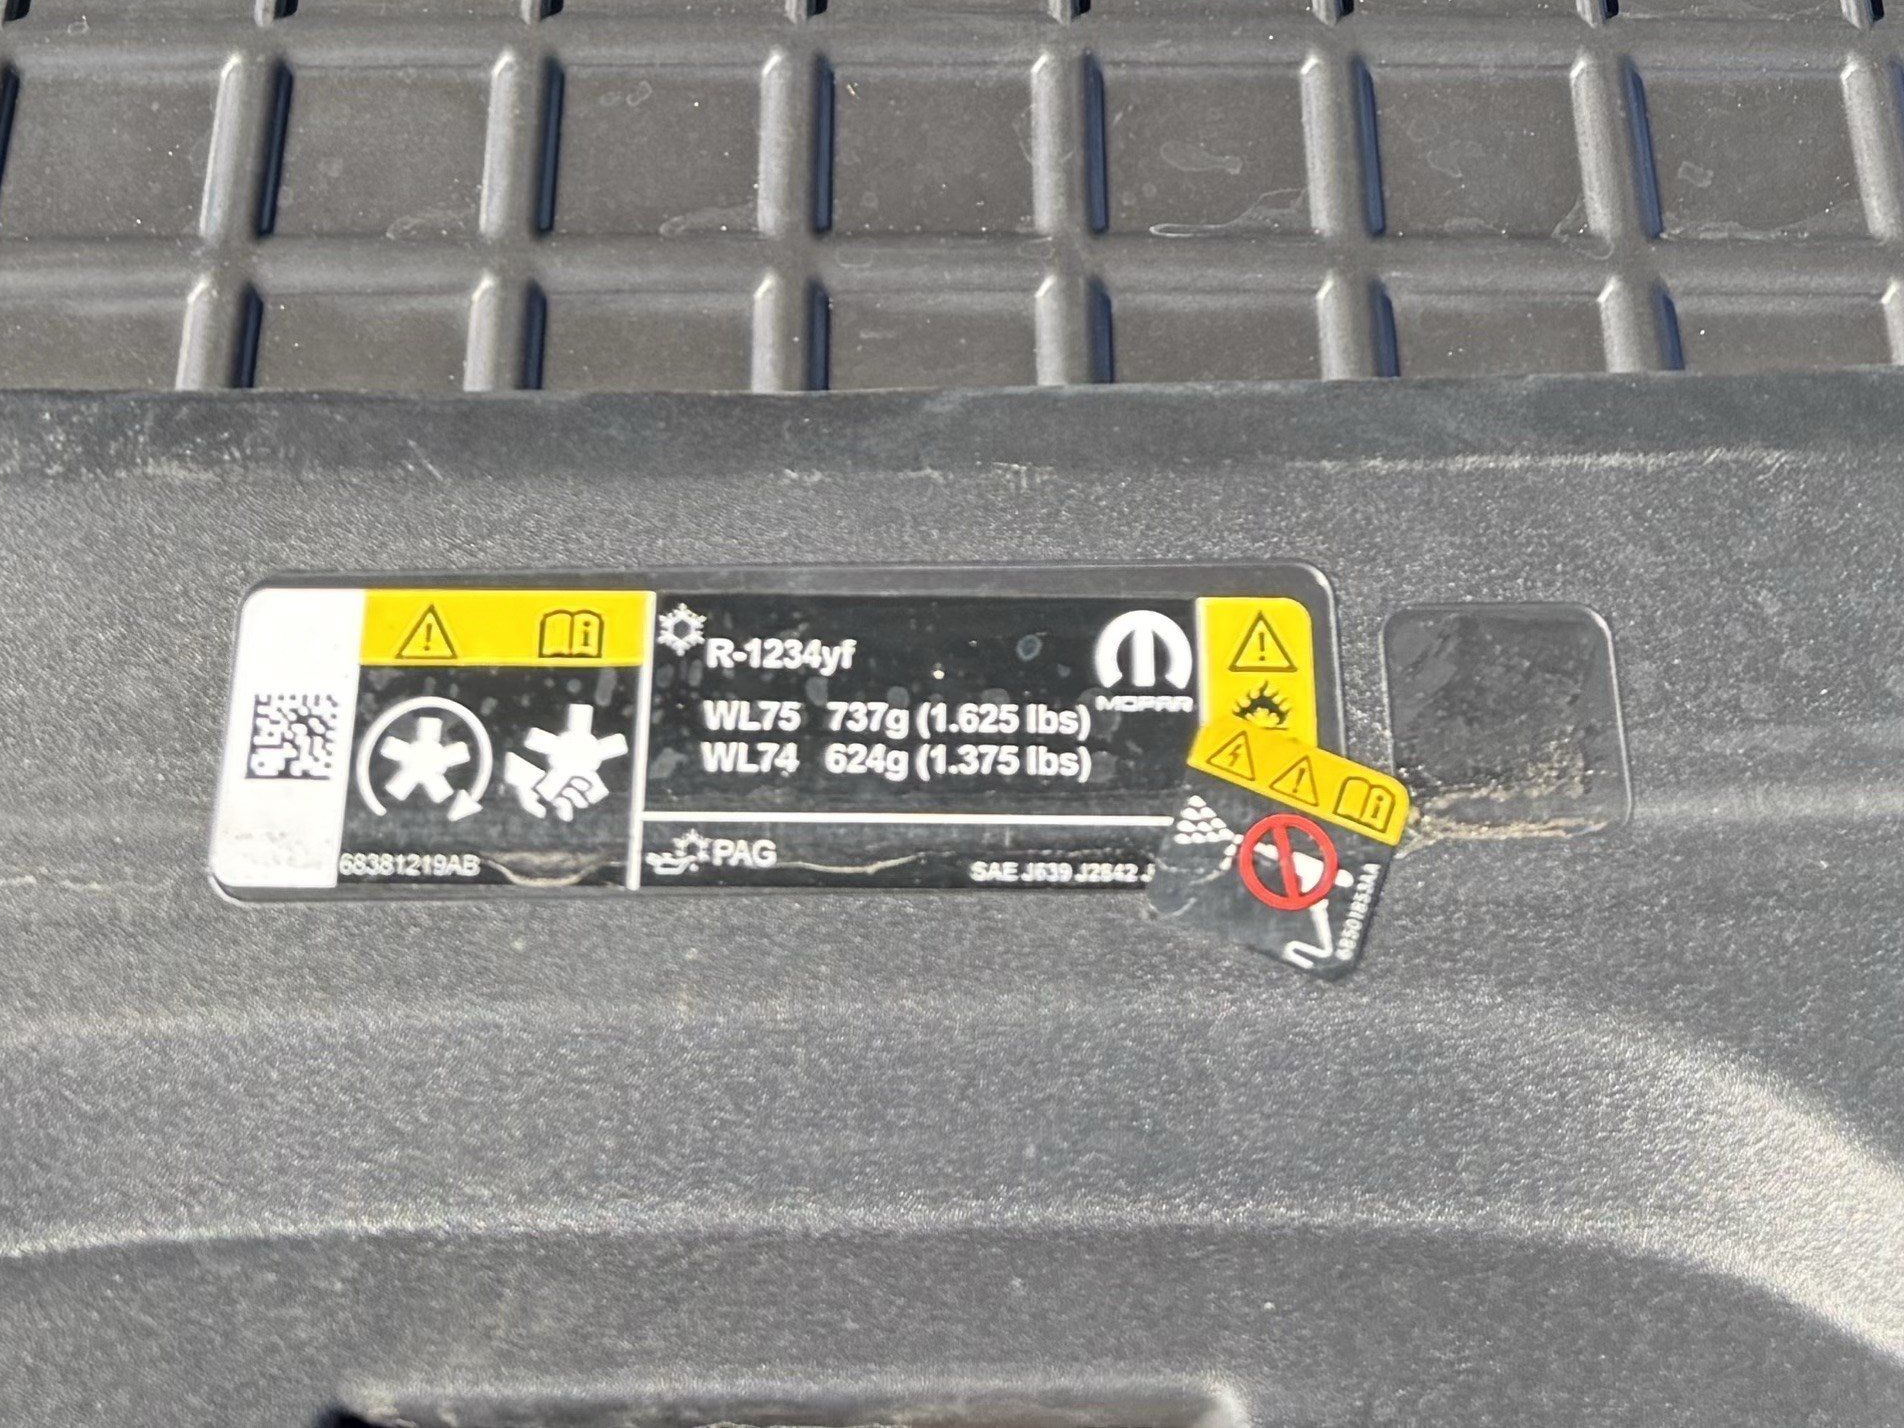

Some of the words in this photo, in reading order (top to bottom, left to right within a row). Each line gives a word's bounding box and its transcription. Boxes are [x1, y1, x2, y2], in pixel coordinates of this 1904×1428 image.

[705, 637, 858, 676] R-1234yf
[1096, 694, 1193, 713] MOPAR
[701, 700, 802, 732] WL75
[827, 701, 910, 740] 737g
[916, 702, 1020, 741] (1.625
[1025, 704, 1093, 741] lbs)
[700, 741, 800, 774] WL74
[824, 743, 910, 782] 624g
[915, 744, 1020, 782] (1.375
[1025, 745, 1093, 783] lbs)
[338, 852, 482, 878] 68381219AB
[712, 838, 779, 869] PAG
[969, 860, 1019, 883] SAE
[1020, 861, 1073, 884] J639
